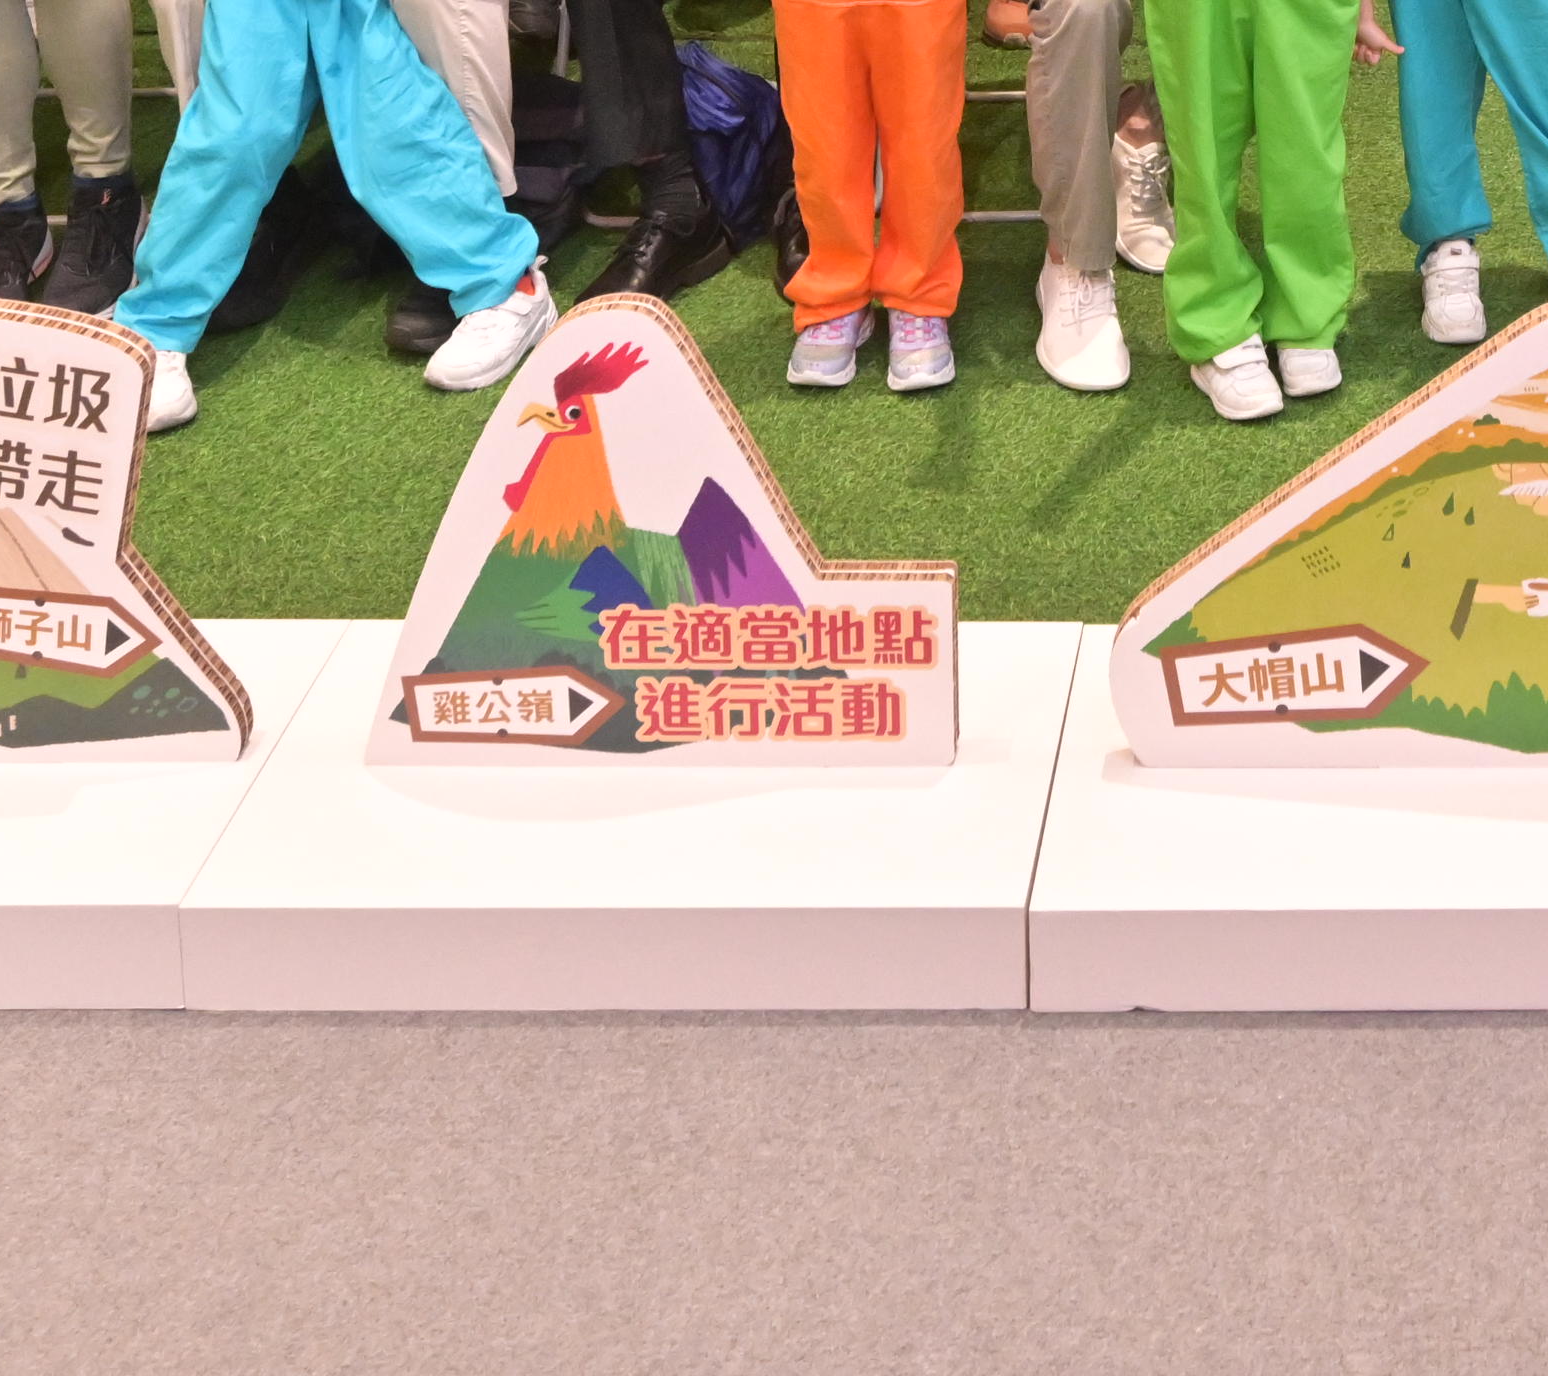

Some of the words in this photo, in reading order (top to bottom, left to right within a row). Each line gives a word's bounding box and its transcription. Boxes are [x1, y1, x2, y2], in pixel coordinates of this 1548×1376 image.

[604, 609, 933, 667] 在適當地點
[432, 689, 555, 726] 雞公嶺
[1198, 654, 1344, 708] 大帽山
[639, 682, 903, 739] 進行活動
